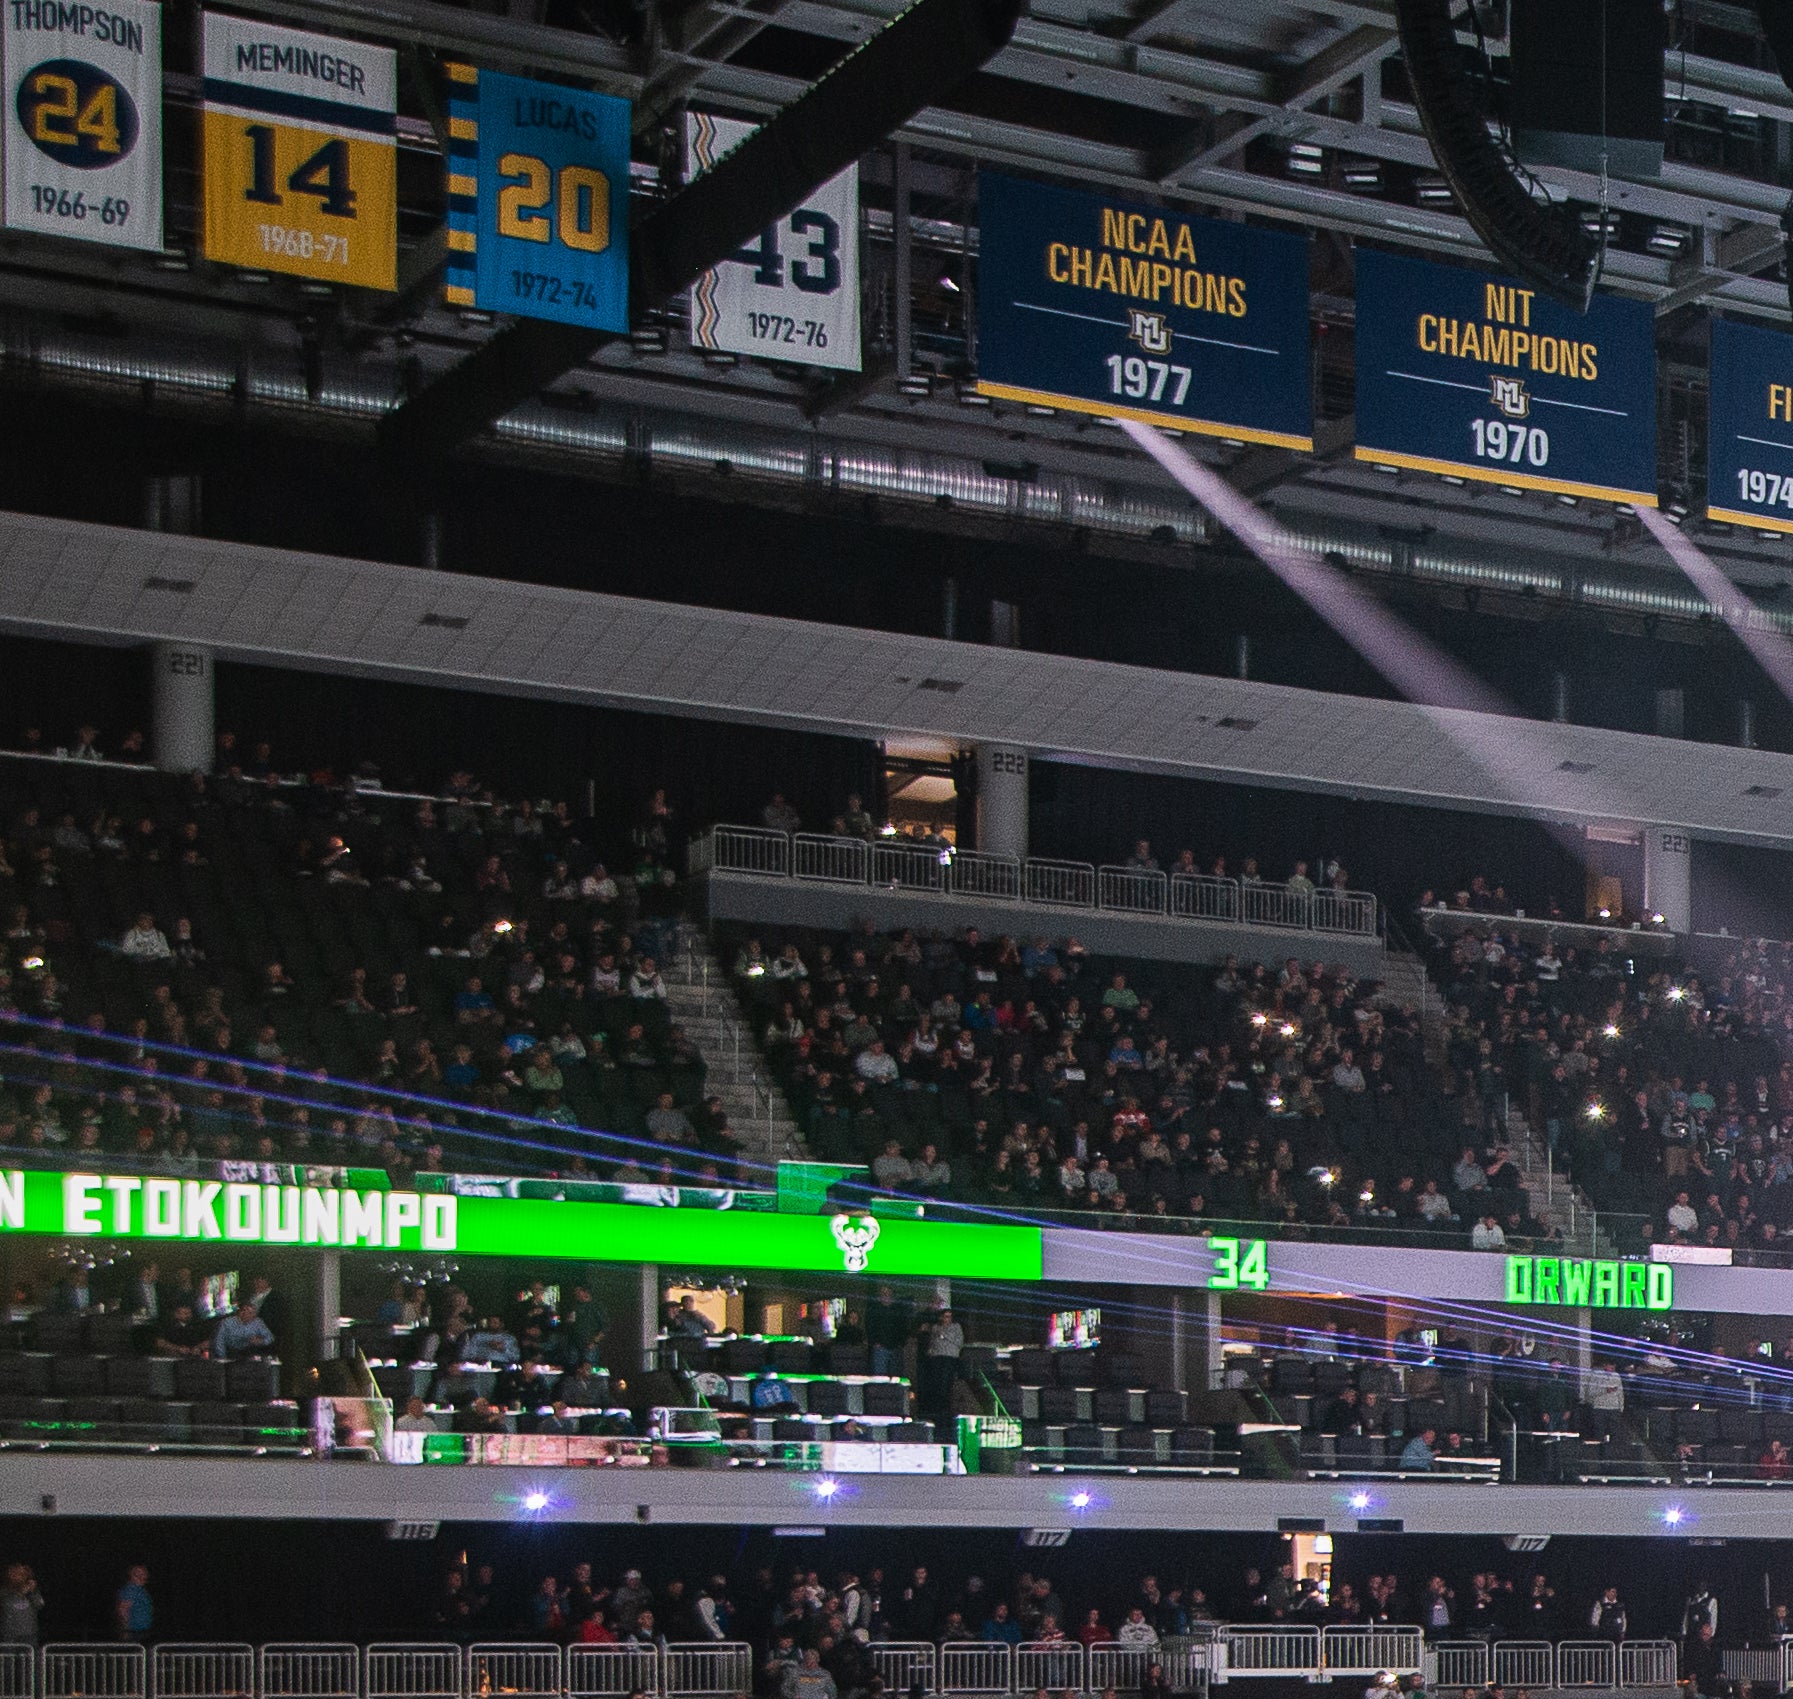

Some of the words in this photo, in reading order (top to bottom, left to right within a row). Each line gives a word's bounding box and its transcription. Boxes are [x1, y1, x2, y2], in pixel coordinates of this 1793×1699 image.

[13, 0, 143, 55] THOMPSON
[237, 44, 366, 98] MEMINGER
[35, 74, 121, 154] 24
[515, 97, 598, 140] LUCAS
[245, 126, 357, 219] 14
[30, 184, 131, 227] 1966-69
[497, 154, 609, 253] 20
[259, 224, 348, 266] 1968-71
[1103, 207, 1197, 264] NCAA
[511, 269, 598, 312] 1972-74
[1048, 242, 1247, 318] CHAMPIONS
[1484, 283, 1535, 327] NIT
[748, 311, 828, 361] 1972-76
[1418, 313, 1599, 382] CHAMPIONS
[1106, 354, 1192, 405] 1977
[1472, 418, 1549, 466] 1970
[66, 1174, 458, 1251] ETOKOUNMPO
[1208, 1236, 1270, 1290] 34
[1505, 1255, 1674, 1310] ORWARD
